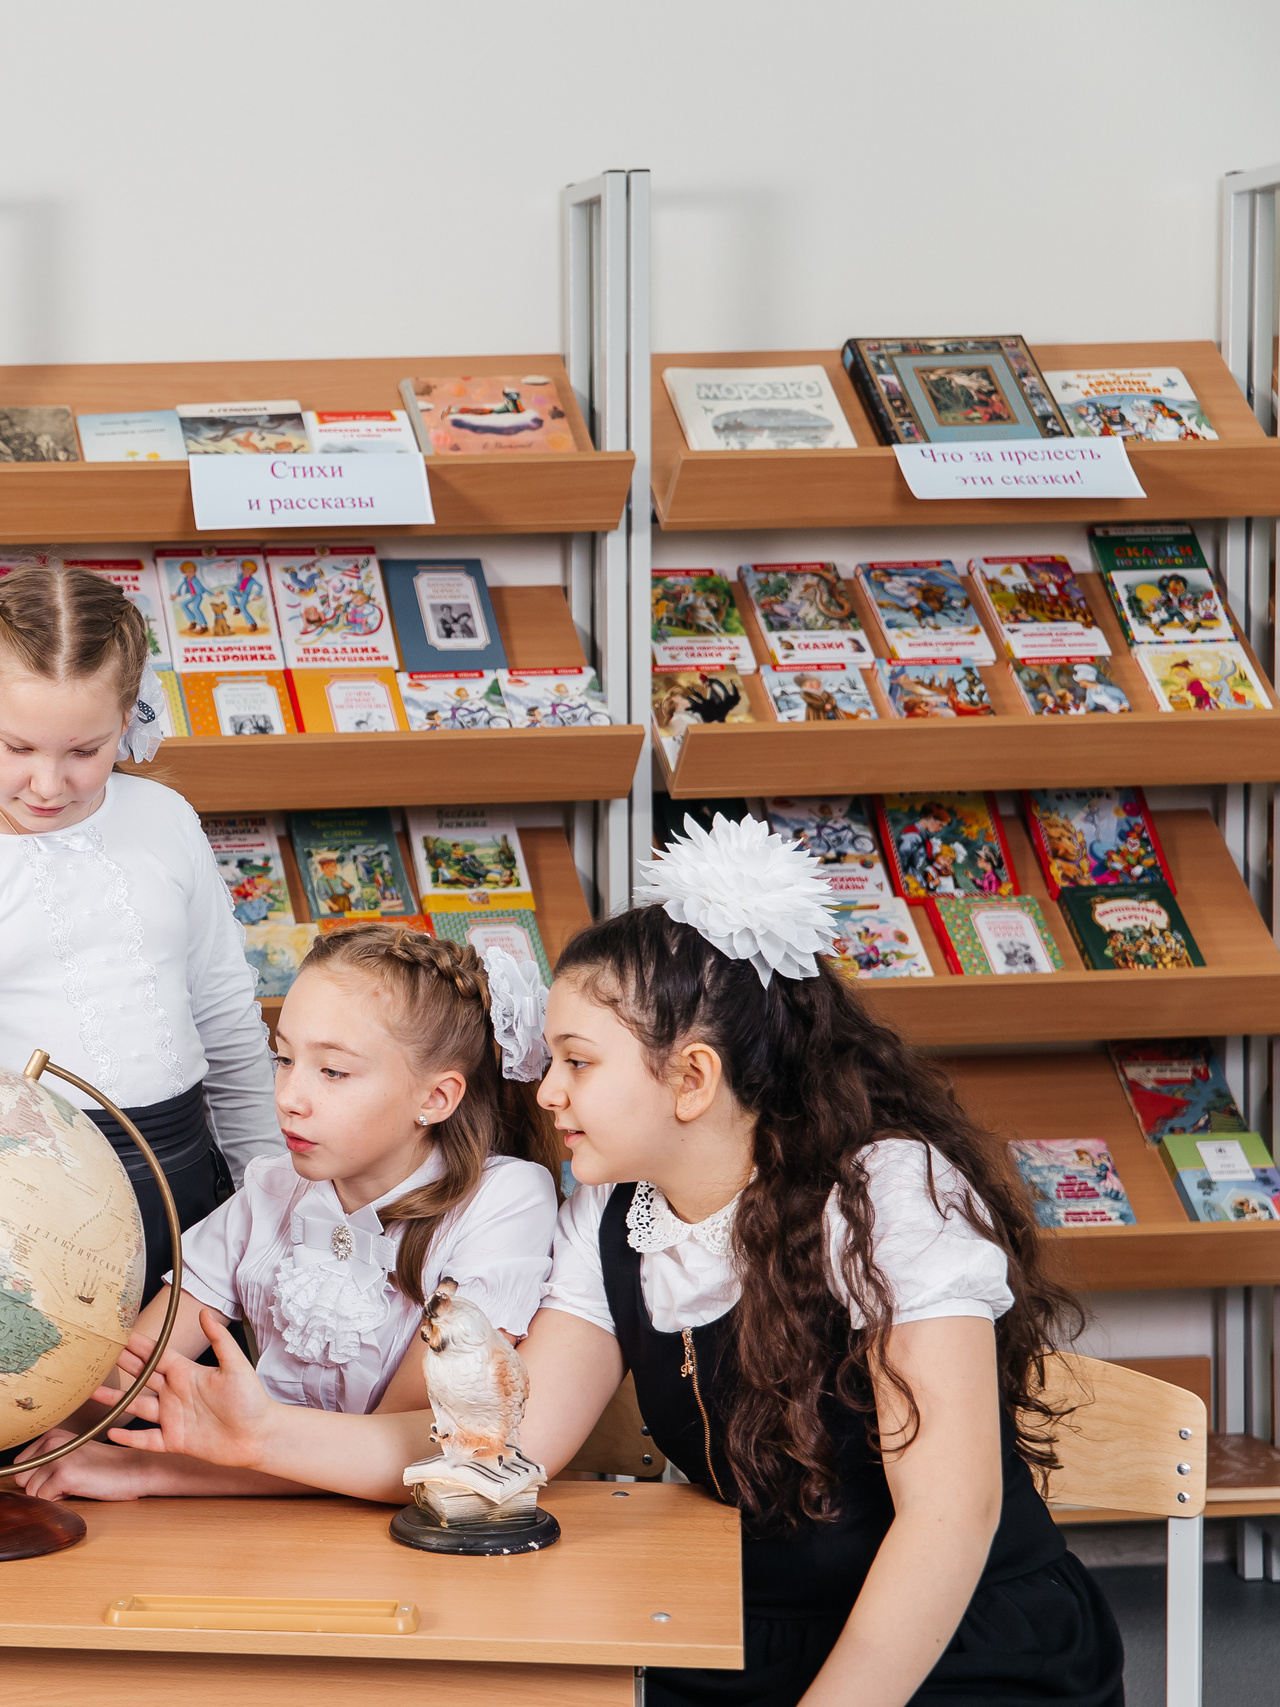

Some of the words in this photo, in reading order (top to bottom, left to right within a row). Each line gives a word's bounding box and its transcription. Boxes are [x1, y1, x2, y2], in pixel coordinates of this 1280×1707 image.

[695, 381, 823, 401] МОРОЗКО
[920, 448, 963, 463] Что
[969, 450, 994, 463] за
[1000, 448, 1101, 466] прелесть
[270, 460, 344, 479] Стихи
[955, 475, 994, 486] эти
[1001, 470, 1084, 486] сказки!
[247, 498, 261, 511] и
[270, 496, 375, 514] рассказы
[1114, 545, 1194, 558] СКАЗКИ
[183, 644, 273, 653] ПРИКЛЮЧЕНИЯ
[302, 646, 380, 655] ПРАЗДНИК
[797, 642, 845, 650] СКАЗКИ
[183, 653, 277, 664] ЭЛЕКТРОНИКА
[203, 817, 267, 827] СТОМАТИЯ
[206, 827, 261, 835] КОЛЬНИКА
